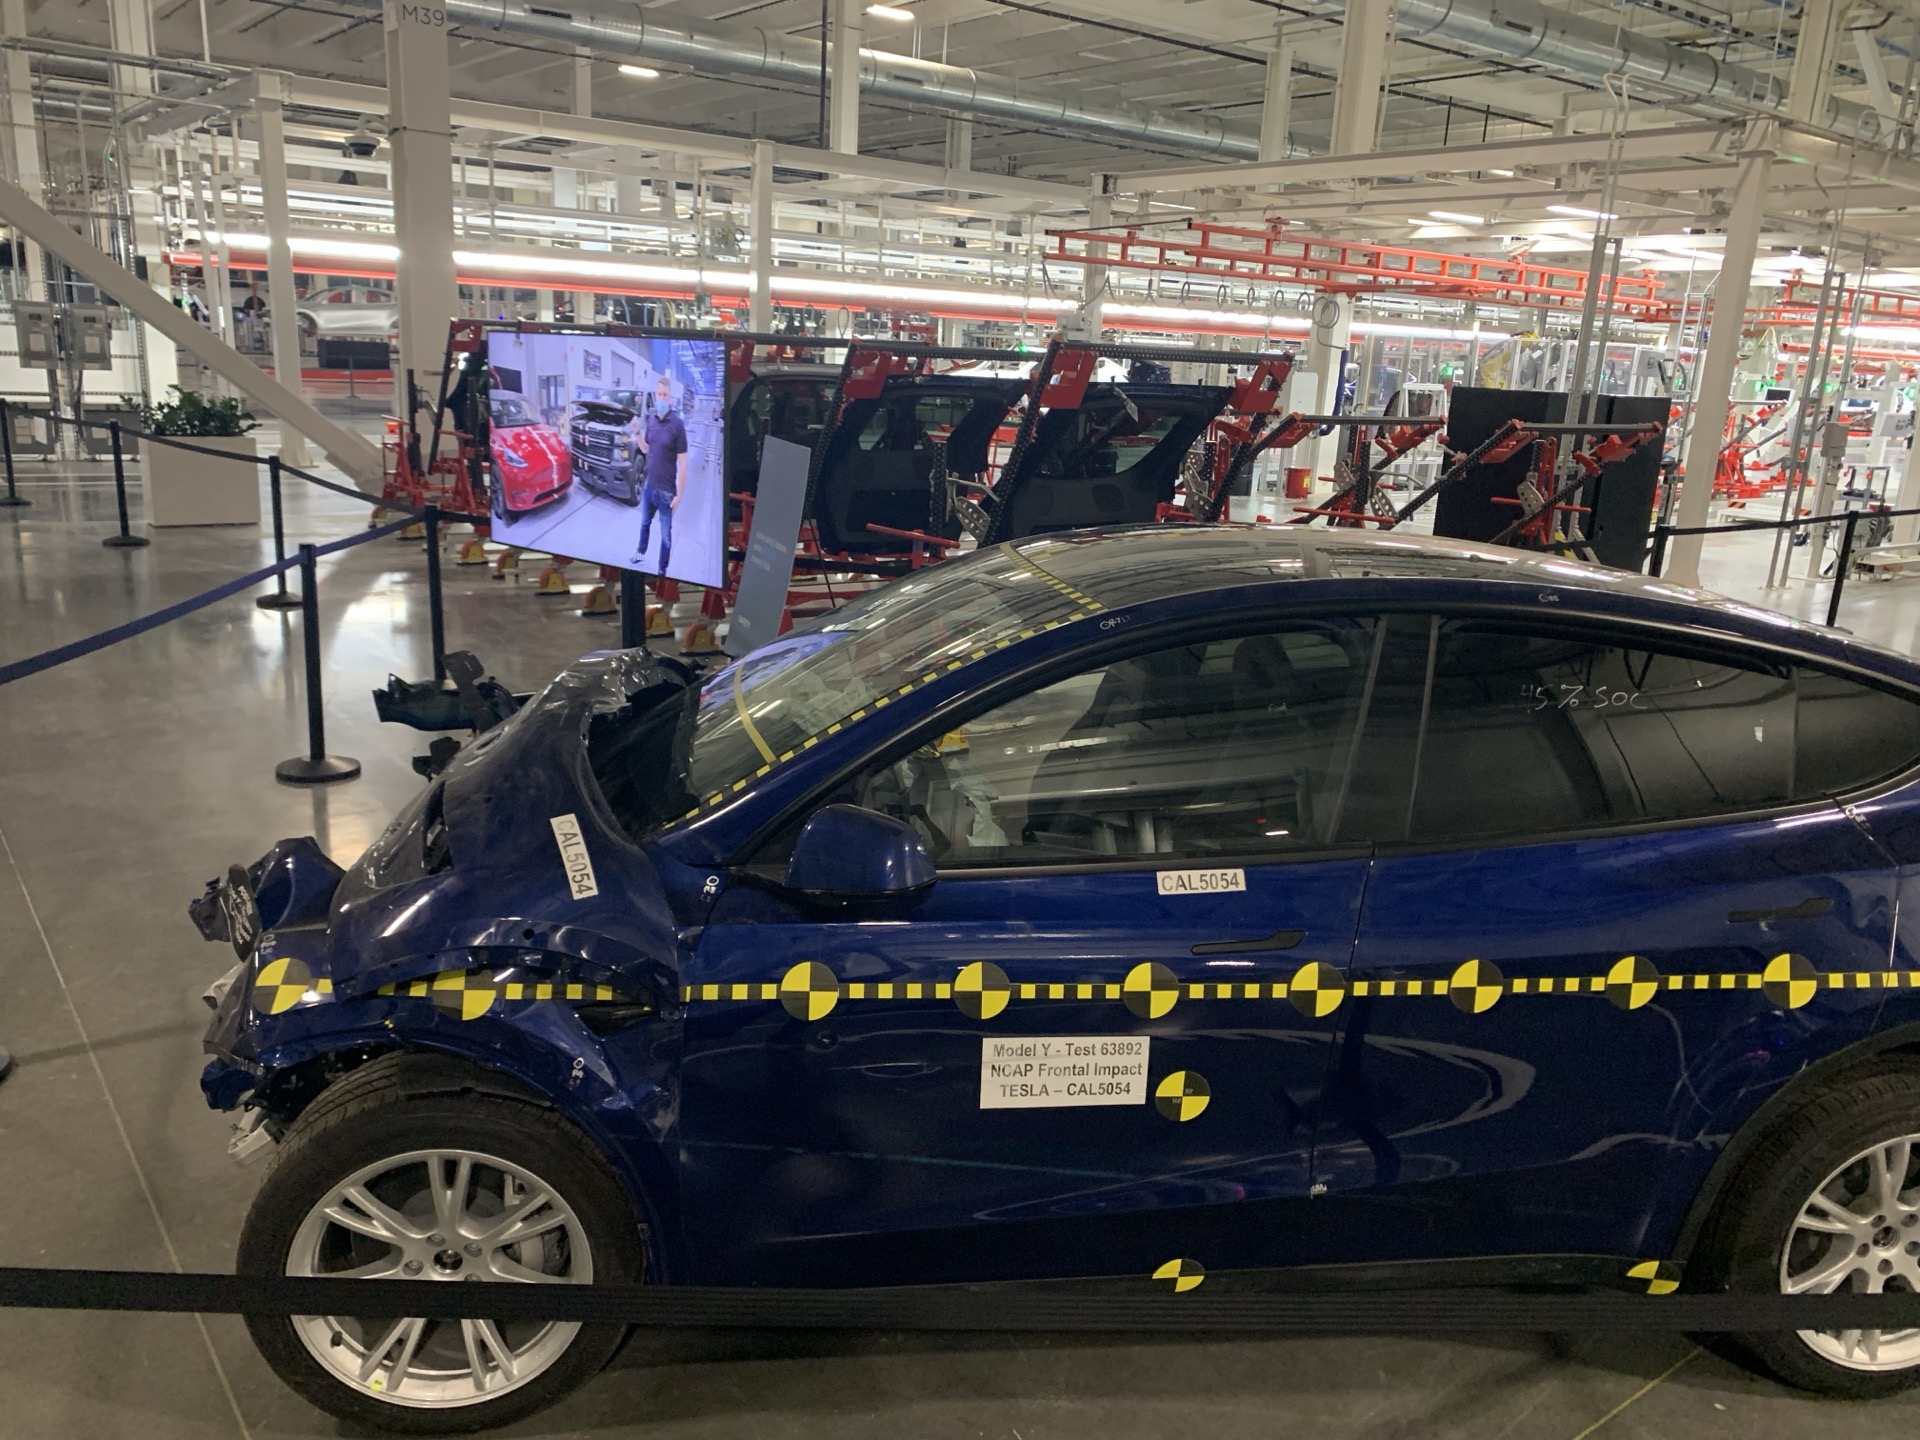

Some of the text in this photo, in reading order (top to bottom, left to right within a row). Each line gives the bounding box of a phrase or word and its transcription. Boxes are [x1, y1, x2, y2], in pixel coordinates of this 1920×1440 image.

[402, 4, 445, 27] M39
[557, 820, 594, 895] CAL5054
[1161, 872, 1240, 892] CAL5054
[993, 1043, 1037, 1057] Model
[1041, 1043, 1052, 1057] Y
[1065, 1042, 1097, 1057] Test
[1100, 1042, 1143, 1056] 63892
[991, 1062, 1143, 1079] NCAP Frontal Impact
[1000, 1083, 1050, 1098] TESLA
[1067, 1082, 1131, 1096] CAL5054
